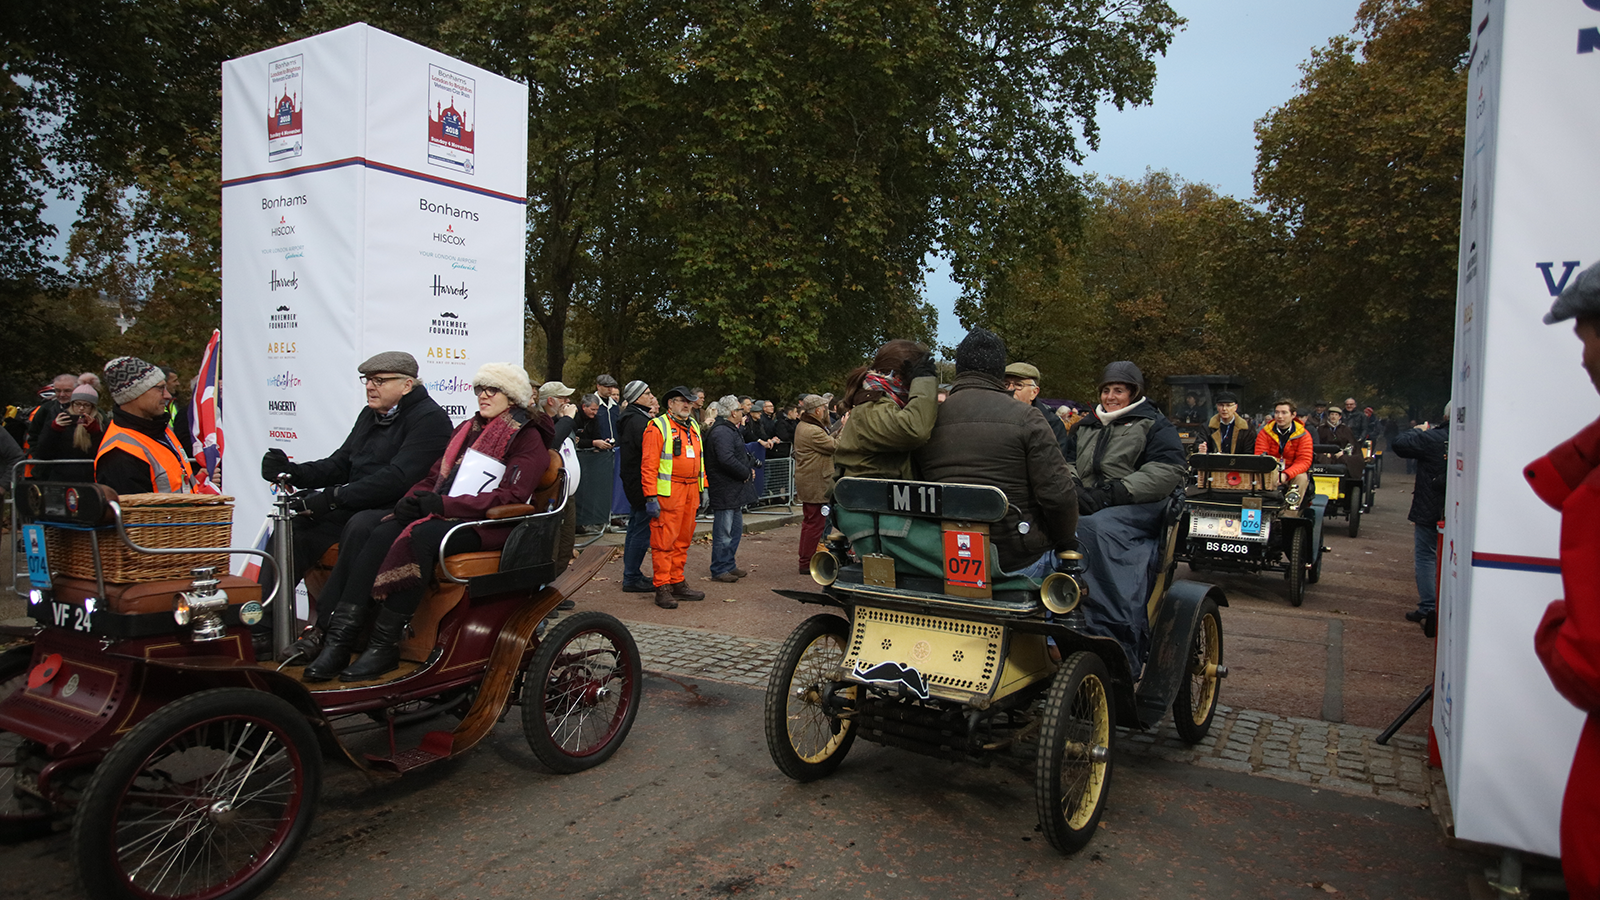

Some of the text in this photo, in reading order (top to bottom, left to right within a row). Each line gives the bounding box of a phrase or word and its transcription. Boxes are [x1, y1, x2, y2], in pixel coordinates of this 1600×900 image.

[438, 69, 467, 85] Bonhams
[445, 125, 459, 135] 2018
[430, 136, 447, 146] Sunday
[451, 142, 473, 152] November
[261, 194, 307, 210] Bonhams
[419, 198, 480, 222] Bonhams
[271, 225, 296, 237] HISCOX
[433, 232, 466, 247] HISCOX
[419, 250, 478, 265] YOUR LONDON AIRPORT
[268, 269, 299, 292] Harrods
[429, 274, 469, 300] Harrods
[270, 313, 297, 321] MOVEMBER
[431, 319, 467, 329] MOVEMBER
[268, 321, 298, 330] FOUNDATION
[428, 327, 469, 337] FOUNDATION
[268, 400, 297, 411] HAGERTY
[269, 430, 298, 440] HONDA
[892, 484, 936, 514] M 11
[1242, 519, 1260, 529] 076
[1206, 541, 1249, 554] BS 8208
[28, 555, 47, 574] 074
[948, 557, 982, 576] 077
[51, 602, 92, 633] VF 24
